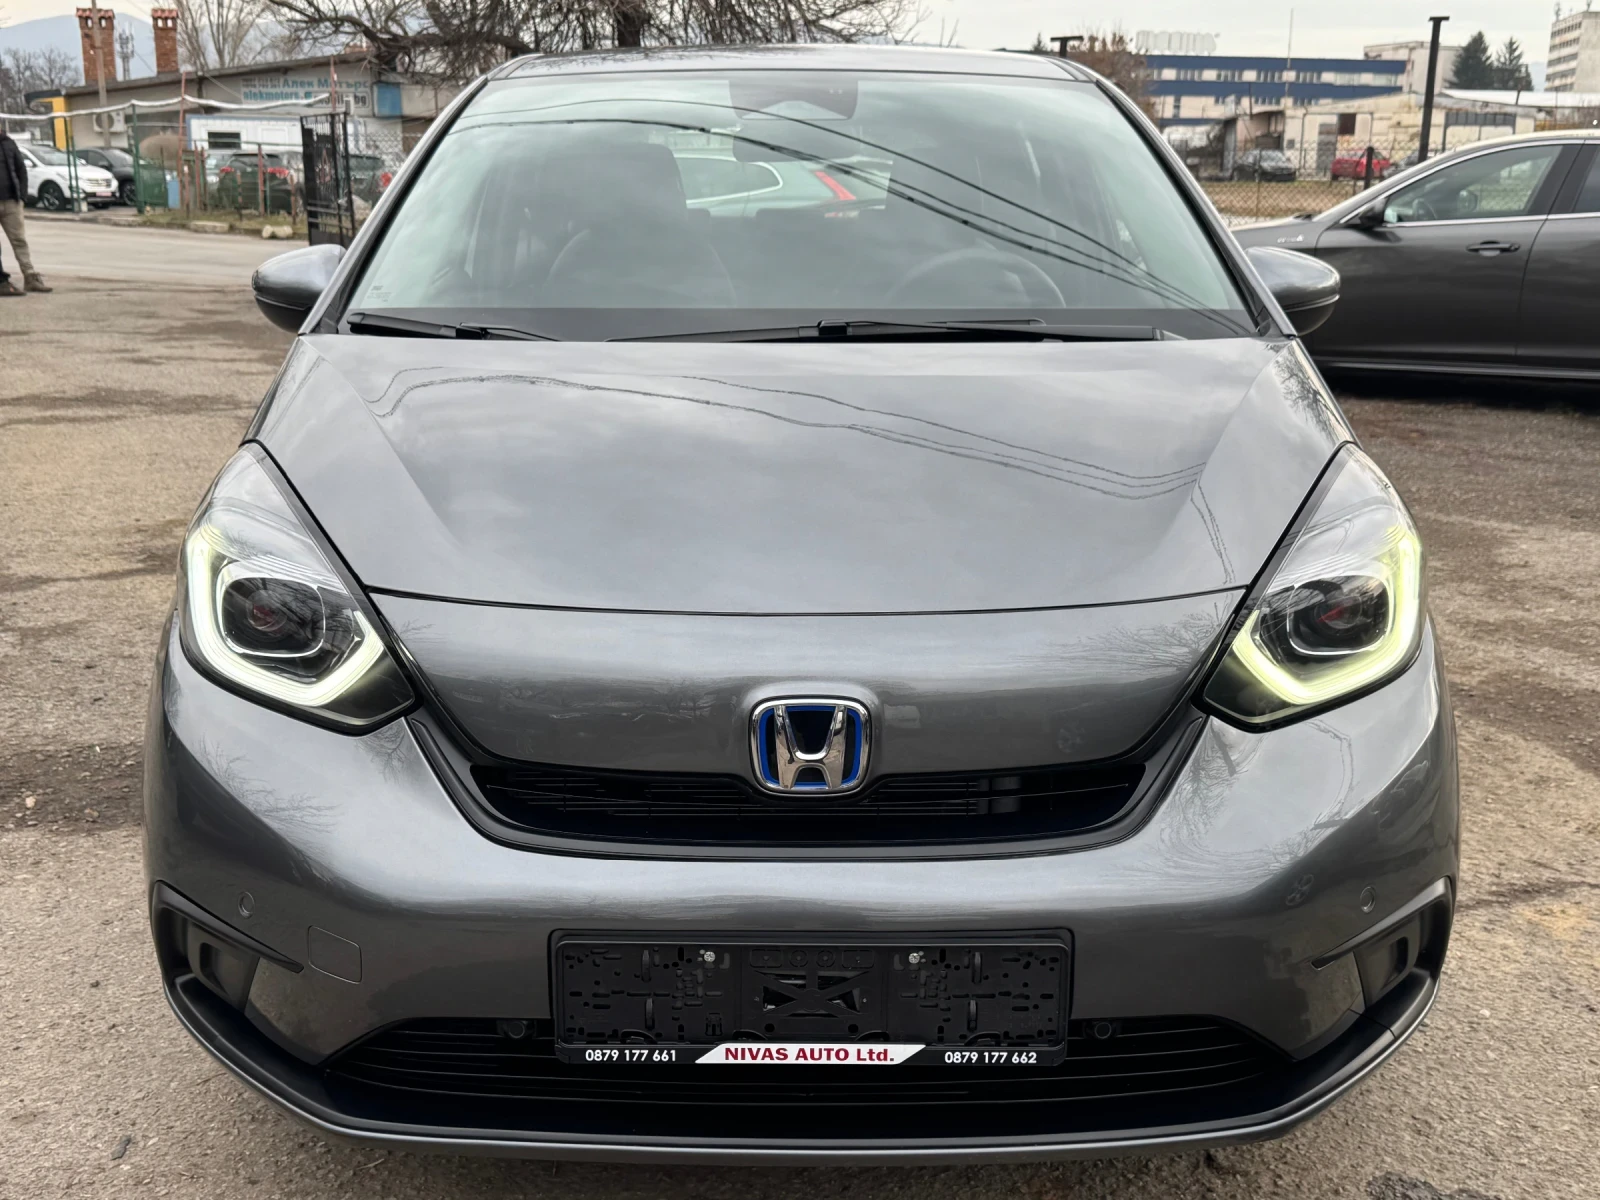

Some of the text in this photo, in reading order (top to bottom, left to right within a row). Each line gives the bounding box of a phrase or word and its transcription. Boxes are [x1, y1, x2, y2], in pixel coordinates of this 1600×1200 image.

[585, 1049, 676, 1062] 0879 177 661
[724, 1047, 895, 1062] NIVAS AUTO Ltd.
[944, 1051, 1037, 1064] 0879 177 662
